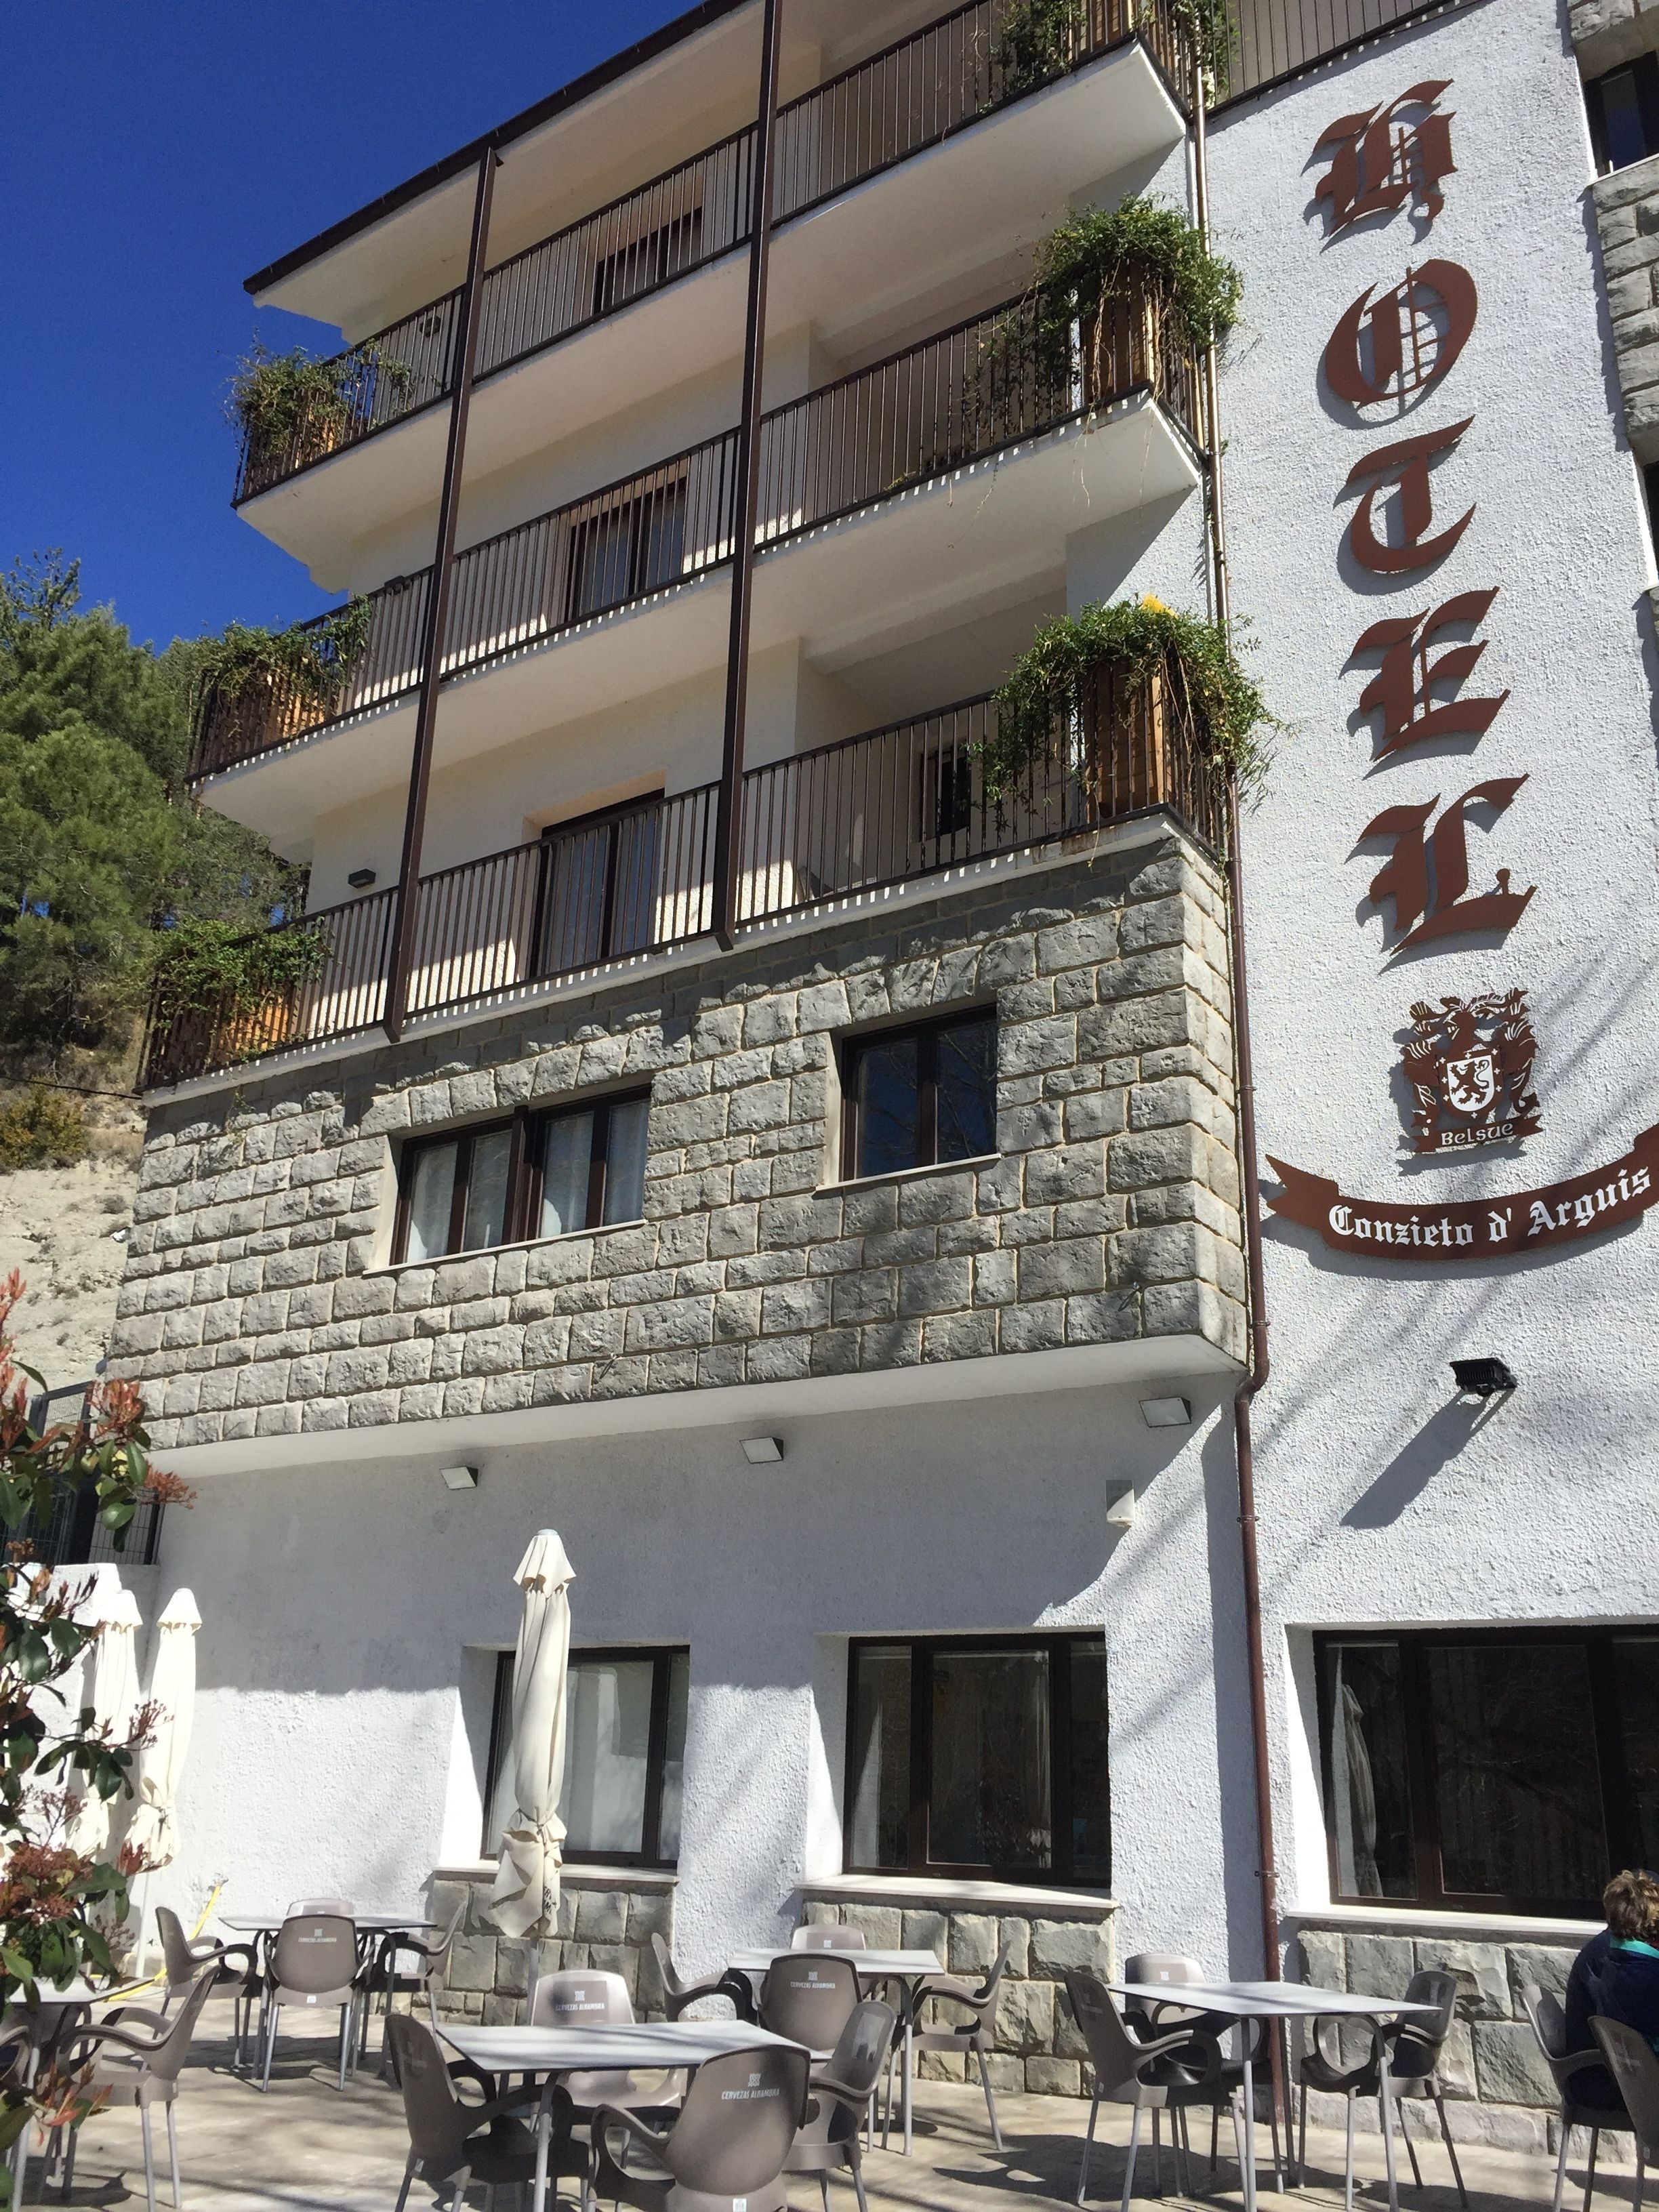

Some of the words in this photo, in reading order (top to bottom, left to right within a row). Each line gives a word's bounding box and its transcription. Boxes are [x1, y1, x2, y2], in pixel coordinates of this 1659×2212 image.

[1313, 78, 1538, 957] HOTEL
[1328, 1204, 1473, 1247] Conzieto
[1488, 1208, 1512, 1242] d'
[1528, 1166, 1652, 1236] Arguis
